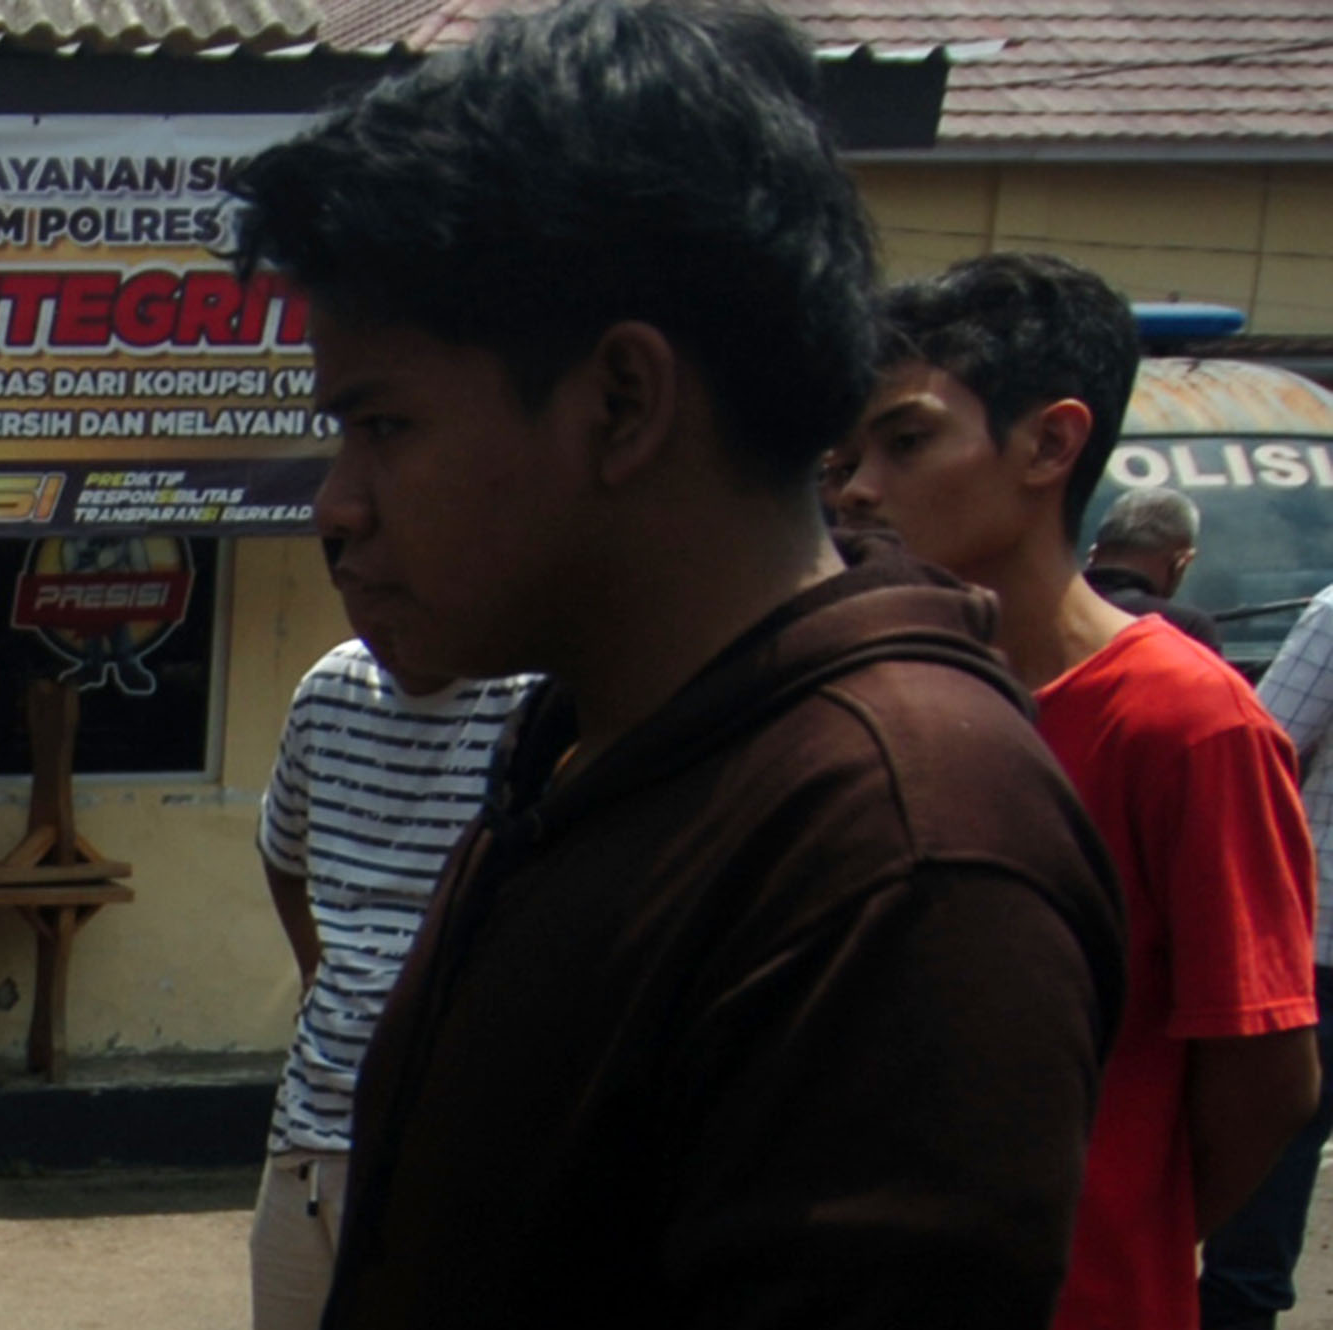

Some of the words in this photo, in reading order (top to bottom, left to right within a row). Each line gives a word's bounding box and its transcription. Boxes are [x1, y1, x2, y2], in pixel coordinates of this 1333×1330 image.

[37, 207, 222, 243] POLRES
[53, 370, 127, 397] DARI
[134, 370, 265, 397] KORUPSI
[79, 410, 144, 437] DAN
[151, 410, 304, 437] MELAYANI
[84, 471, 185, 486] PREDIKTIF
[78, 489, 244, 504] RESPONSIBILITAS
[74, 506, 218, 522] TRANSPARANSI
[33, 580, 170, 611] PRESISI
